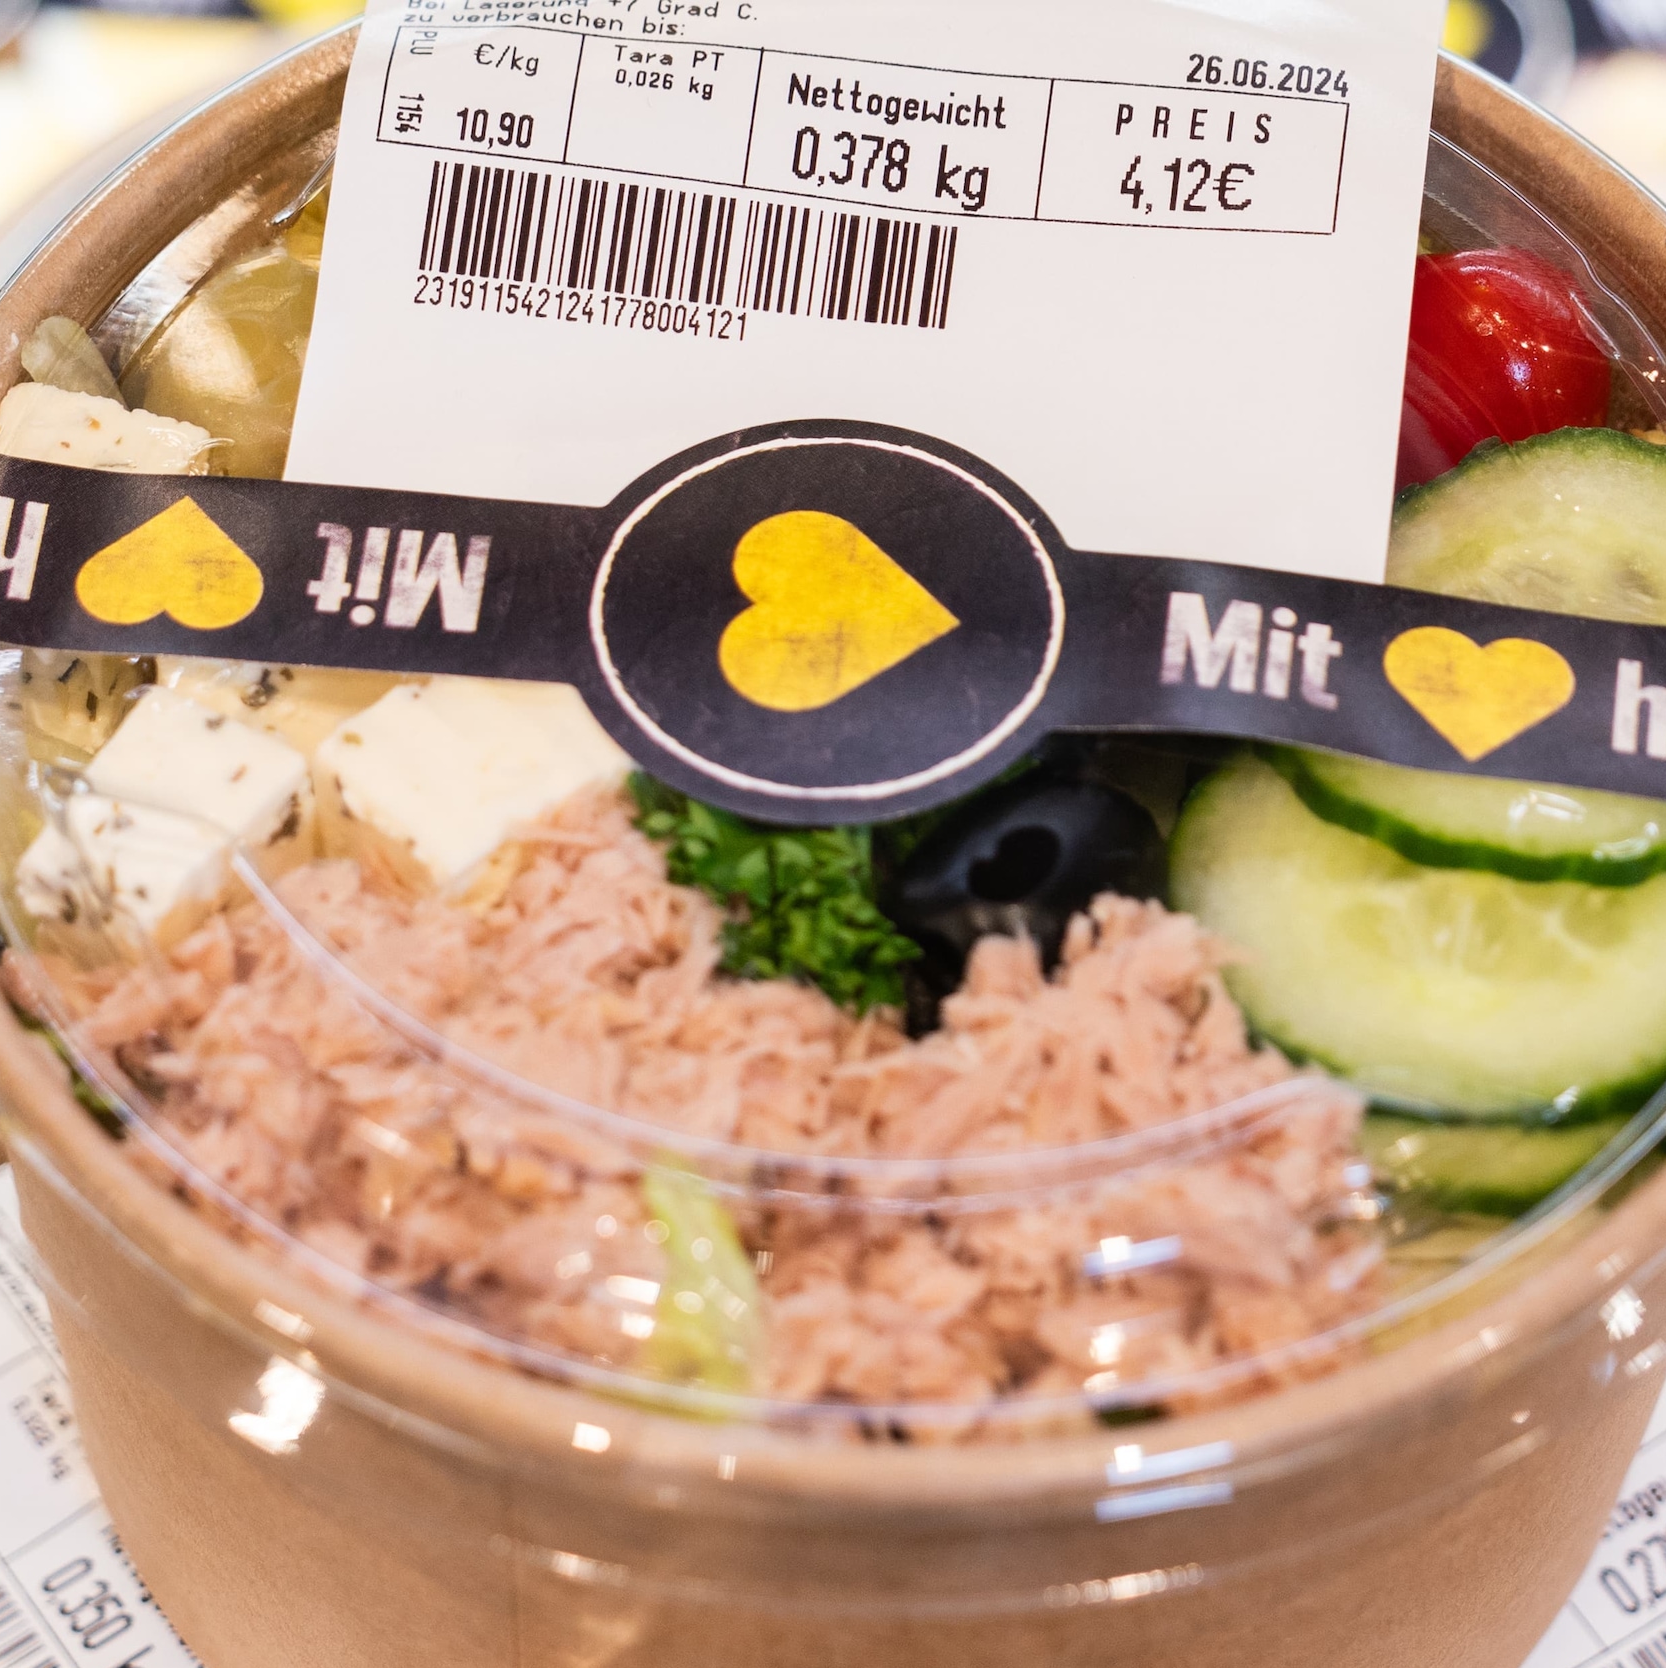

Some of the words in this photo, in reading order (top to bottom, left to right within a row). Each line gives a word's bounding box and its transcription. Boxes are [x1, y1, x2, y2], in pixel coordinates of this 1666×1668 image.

[403, 13, 434, 23] zu
[452, 9, 624, 32] verbrauchen
[641, 15, 686, 36] bis:
[657, 0, 720, 18] Grad
[472, 43, 540, 77] €/kg
[613, 44, 674, 67] Tara
[692, 51, 726, 72] PT
[1185, 53, 1350, 98] 26.06.2024
[614, 68, 675, 91] 0,026
[687, 76, 715, 101] kg
[786, 72, 1008, 131] Nettogewicht
[394, 93, 426, 135] 1154
[455, 106, 536, 150] 10,90
[791, 124, 910, 193] 0,378
[934, 144, 990, 212] kg
[1119, 154, 1256, 215] 4,12€
[413, 274, 747, 341] 2319115421241778004121
[305, 521, 492, 633] Mit
[1160, 591, 1343, 711] Mit
[40, 1556, 134, 1651] 0,350
